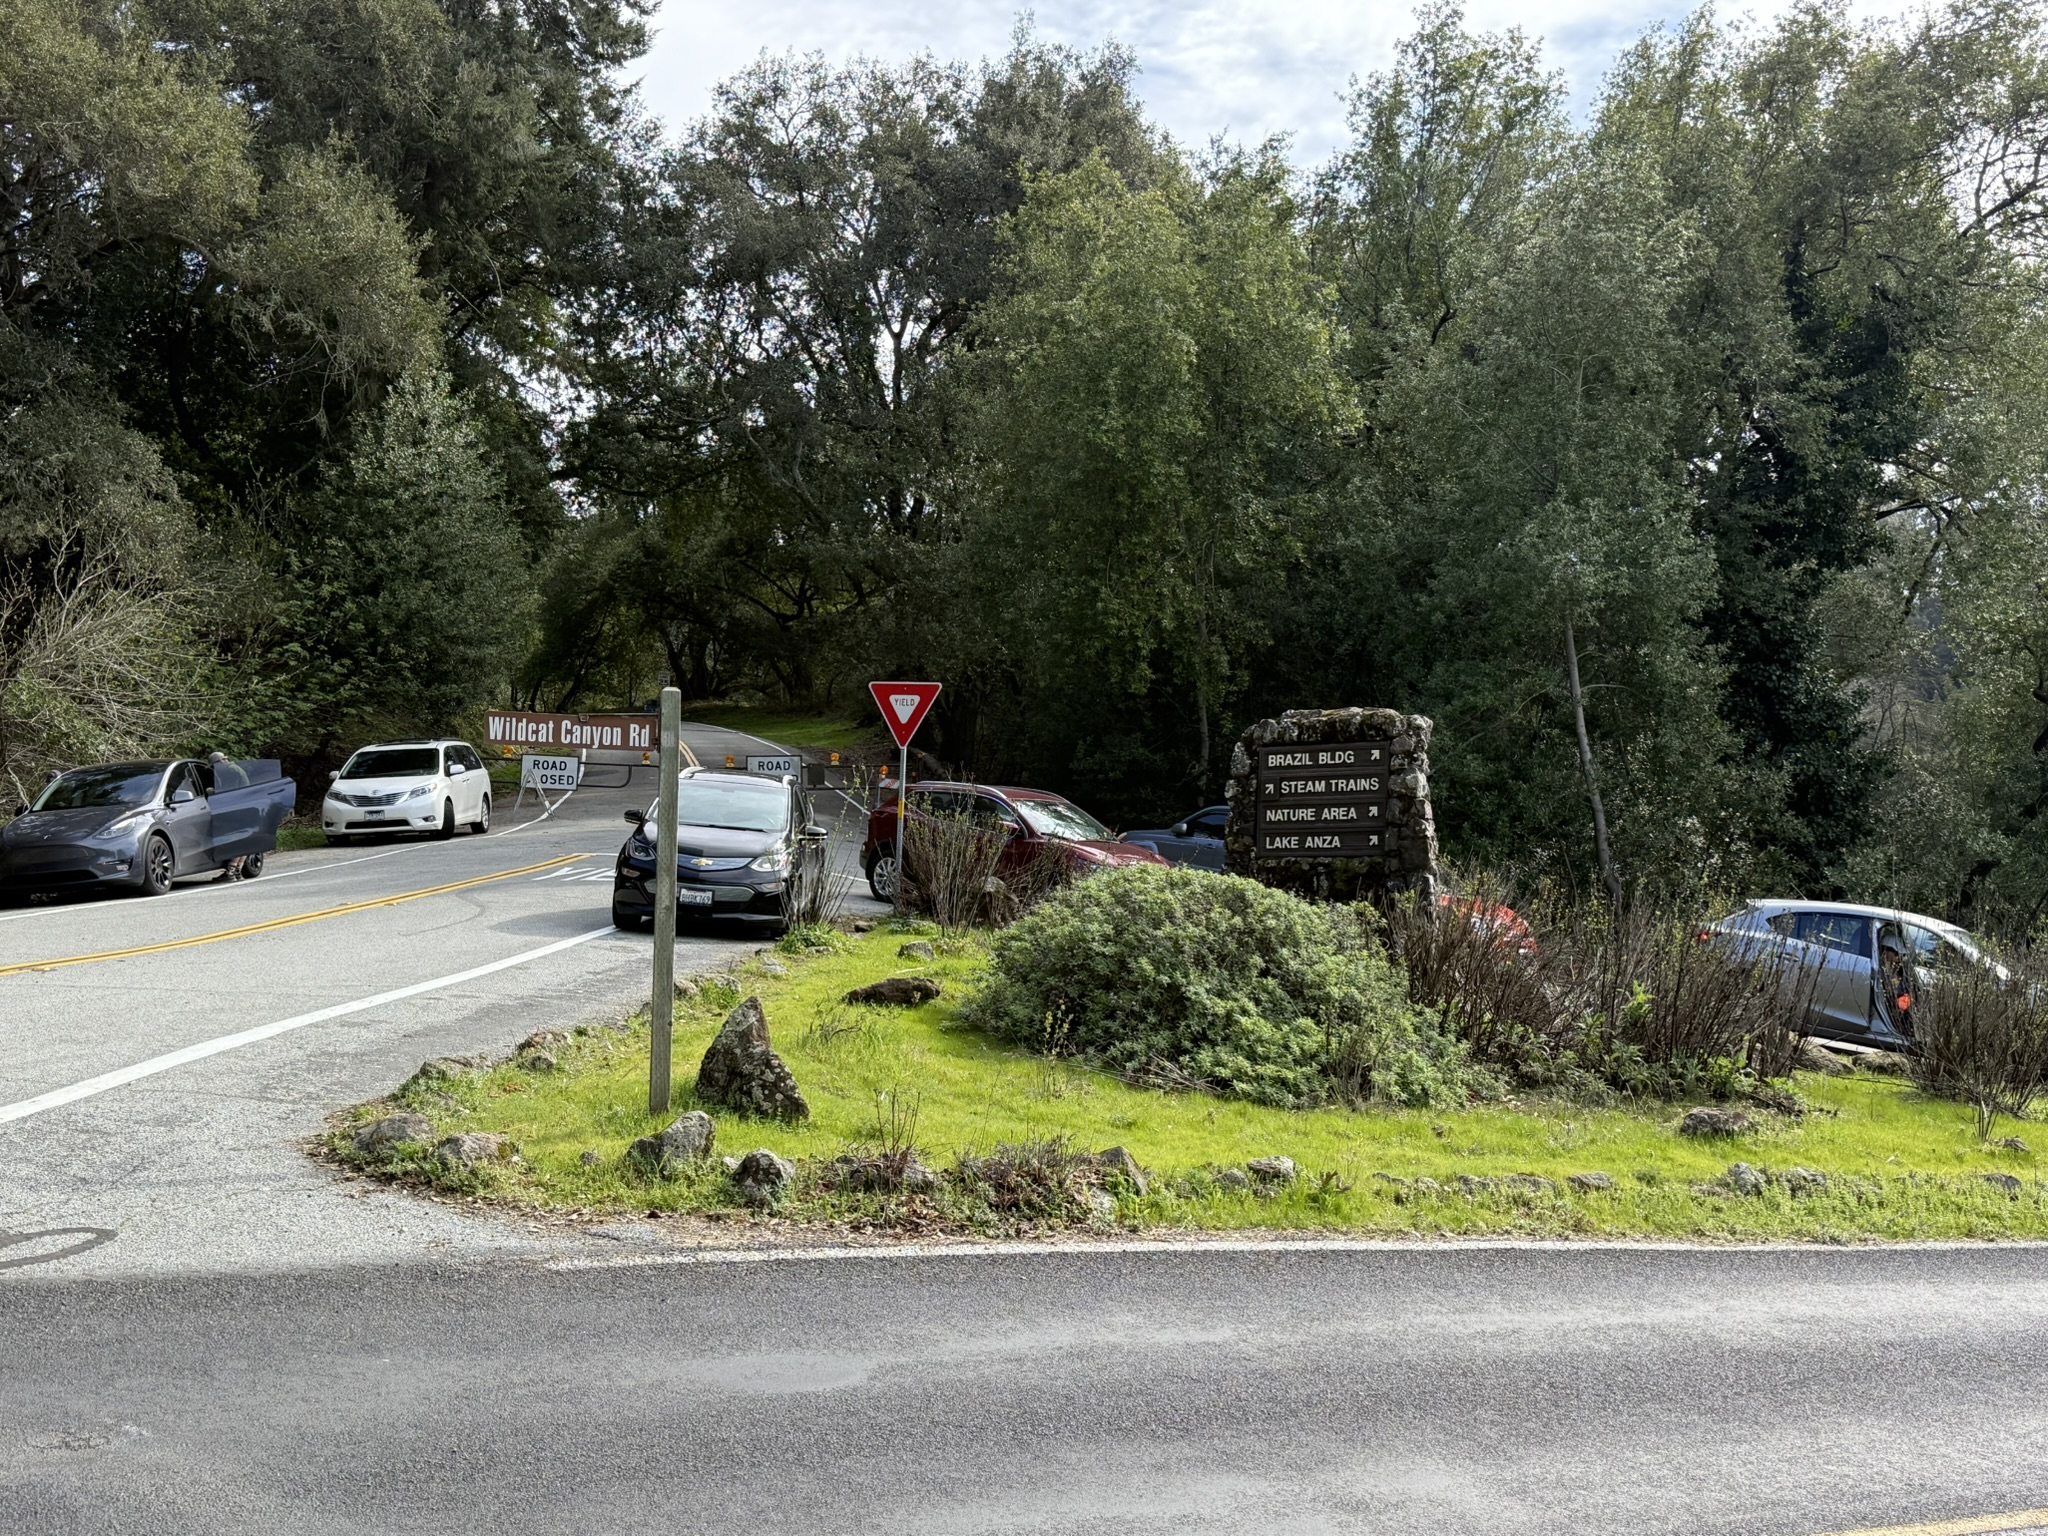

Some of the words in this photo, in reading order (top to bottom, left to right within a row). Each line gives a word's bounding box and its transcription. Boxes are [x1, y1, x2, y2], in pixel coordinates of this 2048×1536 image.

[894, 698, 915, 706] YIELD
[488, 716, 554, 743] Wildcat
[561, 719, 622, 748] Canyon
[629, 723, 650, 747] Rd
[533, 759, 567, 771] ROAD
[758, 760, 791, 771] ROAD
[1268, 753, 1313, 767] BRAZIL
[1318, 750, 1355, 764] BLDG
[527, 774, 574, 785] OSED
[1281, 780, 1325, 794] STEAM
[1329, 778, 1379, 792] TRAINS
[1266, 808, 1316, 822] NATURE
[1321, 807, 1357, 820] AREA
[1266, 836, 1299, 849] LAKE
[1305, 835, 1340, 848] ANZA
